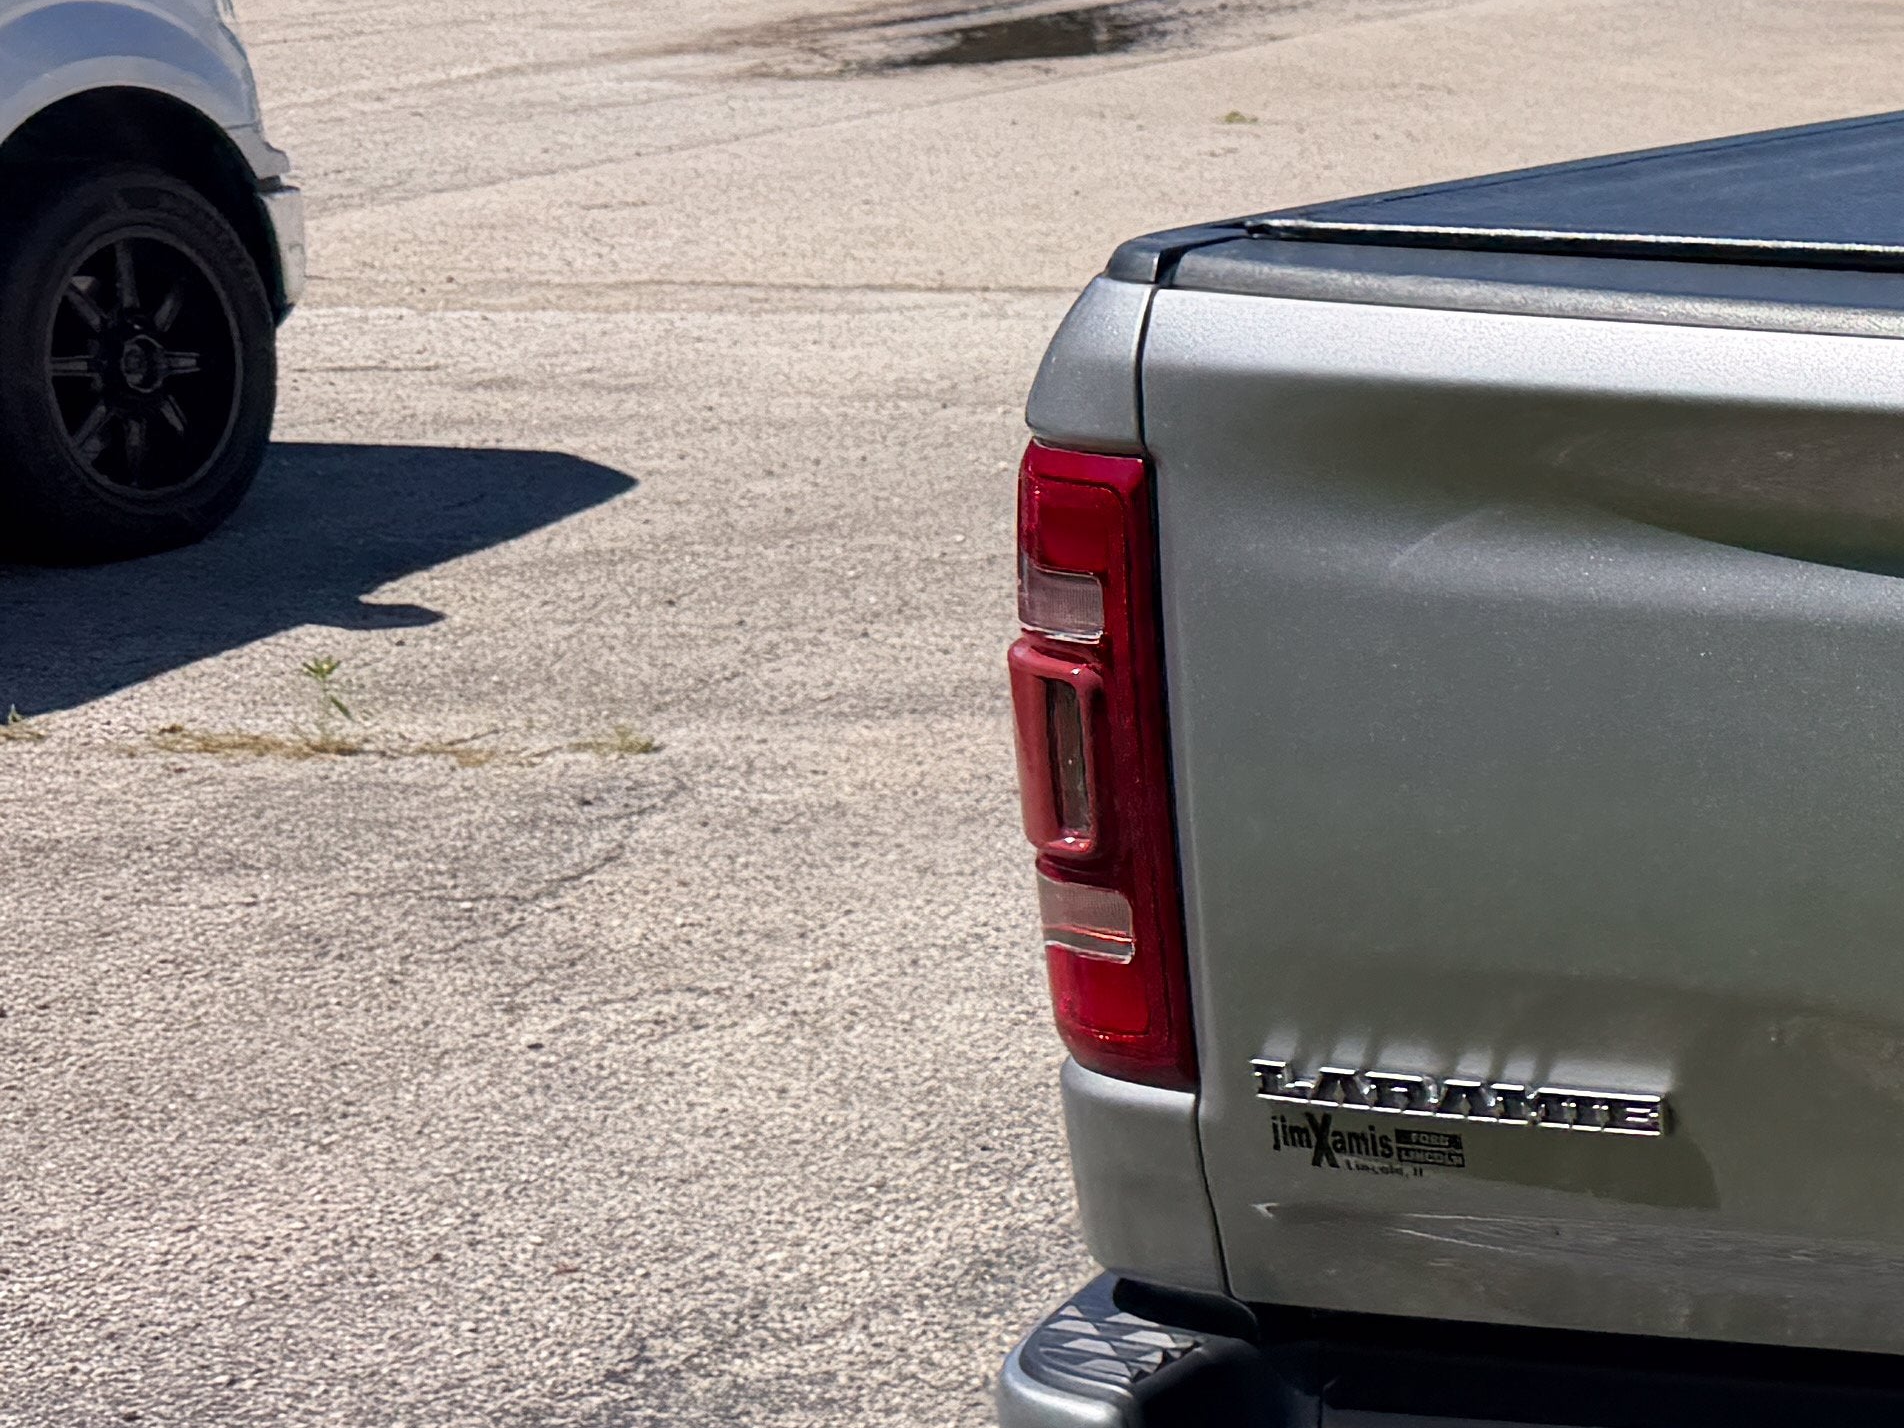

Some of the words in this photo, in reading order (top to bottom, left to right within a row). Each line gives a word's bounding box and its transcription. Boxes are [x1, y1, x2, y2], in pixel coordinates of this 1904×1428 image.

[1249, 1058, 1663, 1137] LARAMIE
[1410, 1132, 1450, 1147] FORD
[1400, 1149, 1464, 1167] LINCOLN
